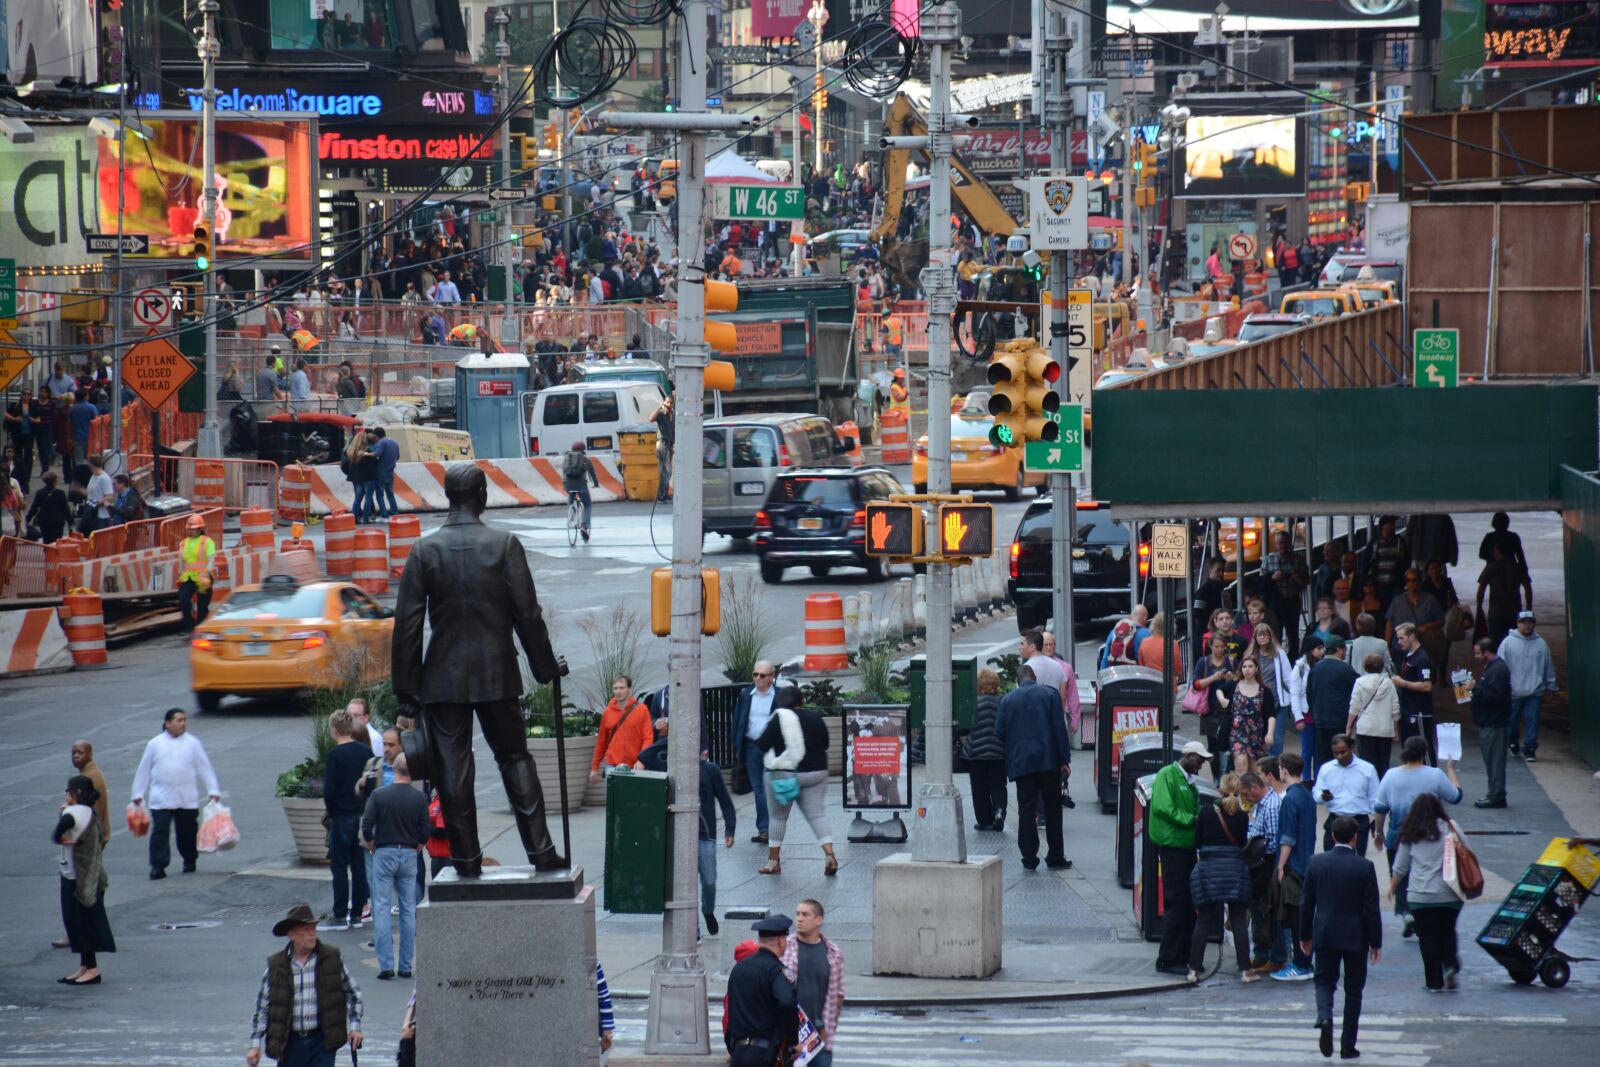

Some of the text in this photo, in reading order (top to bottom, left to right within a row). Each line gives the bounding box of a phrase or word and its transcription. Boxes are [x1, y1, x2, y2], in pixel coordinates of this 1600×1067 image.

[436, 92, 465, 114] NEWS
[425, 138, 458, 160] case
[606, 143, 642, 156] FedEx
[735, 188, 800, 216] W 46 ST
[1047, 218, 1071, 226] SECURITY
[95, 238, 139, 249] ONE WAY
[1049, 236, 1070, 244] CAMERA
[752, 343, 779, 351] FOLLOW
[129, 355, 178, 366] LEFT LANE
[1419, 353, 1454, 363] Broadway
[137, 369, 172, 379] CLOSED
[140, 381, 171, 391] AHEAD
[1065, 431, 1080, 444] St
[1156, 551, 1184, 560] WALK
[1158, 562, 1181, 571] BIKE
[1114, 709, 1158, 731] JERSEY
[475, 980, 482, 988] a
[484, 977, 513, 990] Grand
[515, 976, 533, 986] Old
[535, 975, 556, 989] Flag
